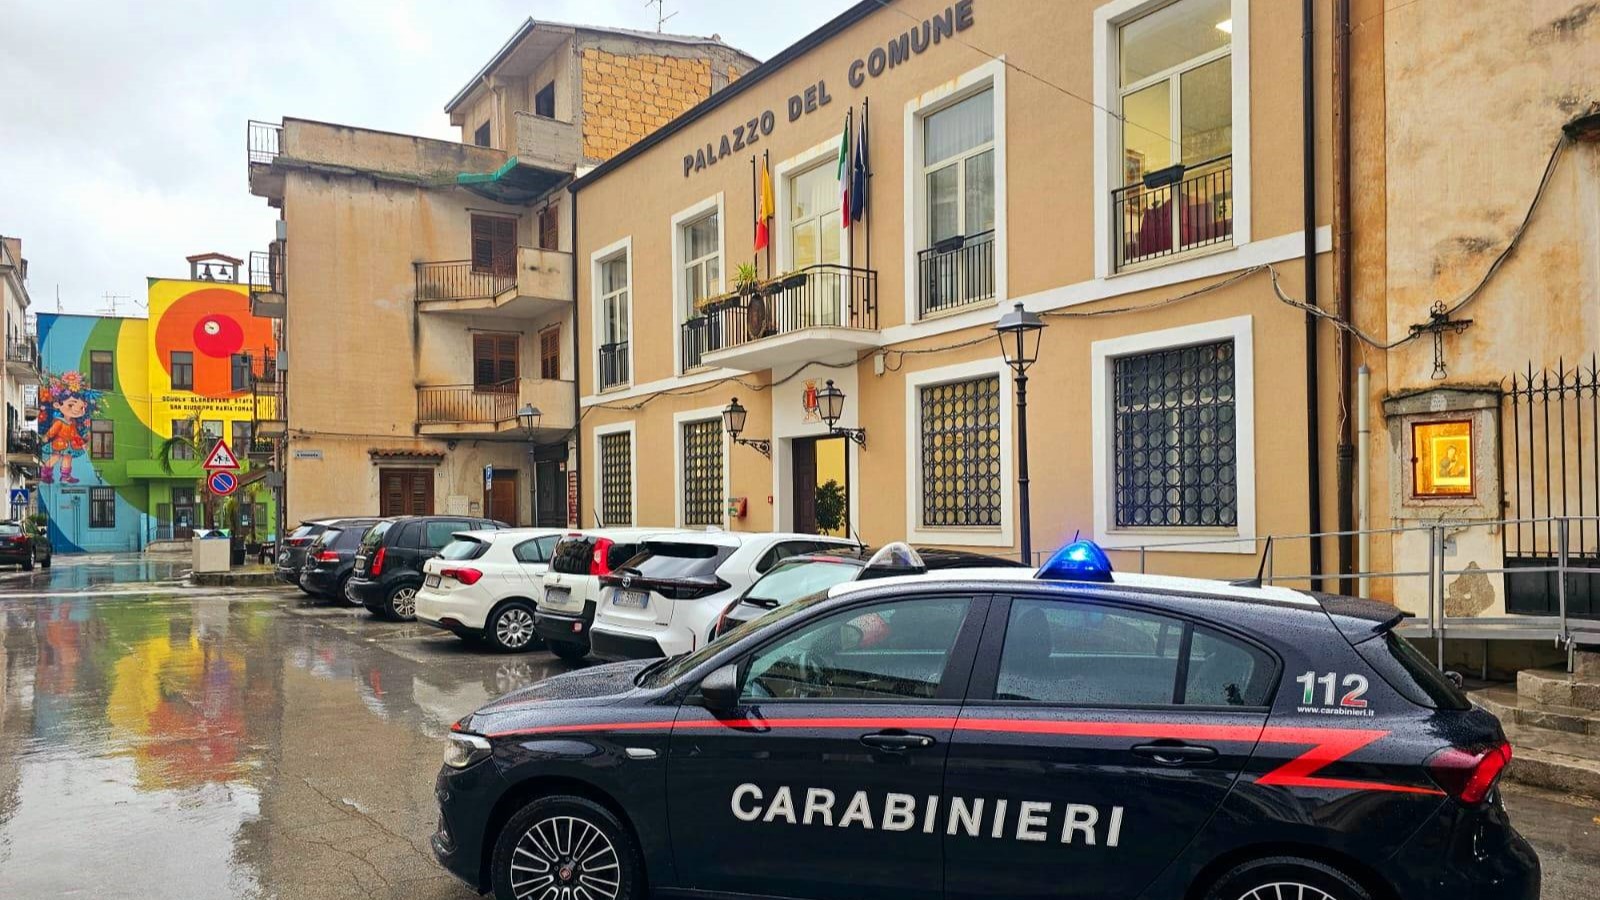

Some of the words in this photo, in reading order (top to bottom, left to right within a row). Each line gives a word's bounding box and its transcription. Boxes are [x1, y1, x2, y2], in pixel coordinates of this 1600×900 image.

[683, 110, 775, 177] PALAZZO
[788, 80, 832, 122] DEL
[848, 0, 974, 88] COMUNE
[1297, 671, 1368, 707] 112
[1297, 707, 1374, 716] www.carabinieri.it
[730, 783, 1123, 847] CARABINIERI
